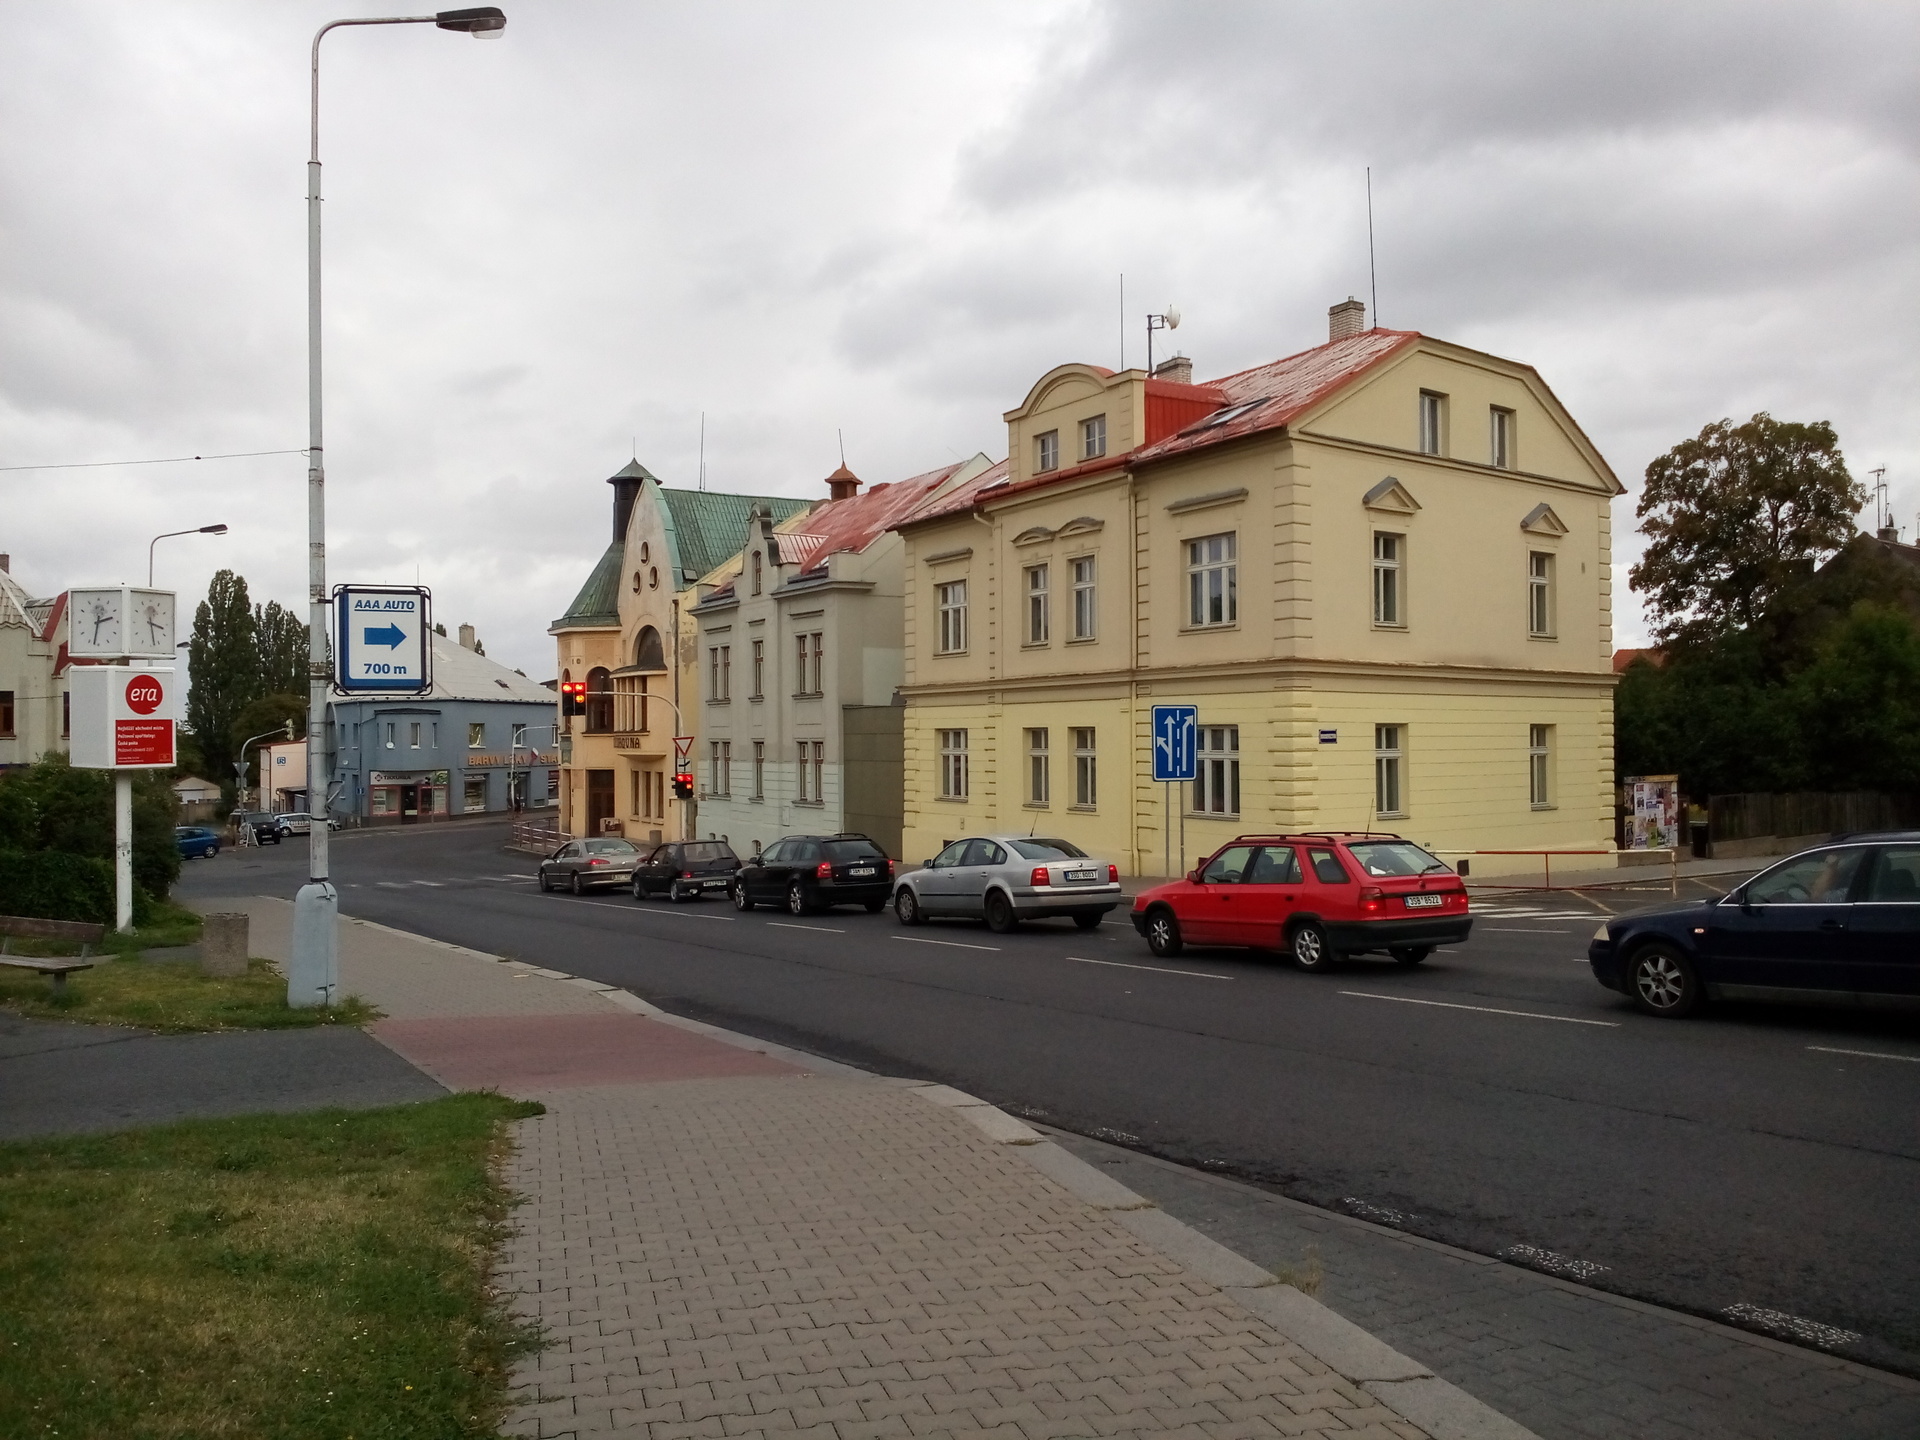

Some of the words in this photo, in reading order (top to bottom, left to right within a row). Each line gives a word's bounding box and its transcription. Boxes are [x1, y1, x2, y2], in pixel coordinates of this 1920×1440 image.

[354, 600, 380, 609] AAA
[384, 600, 415, 610] AUTO
[364, 664, 390, 674] 700
[394, 666, 407, 674] m
[130, 688, 158, 701] era
[467, 755, 501, 766] BARVY
[540, 754, 559, 764] STA
[1424, 896, 1440, 904] 8522
